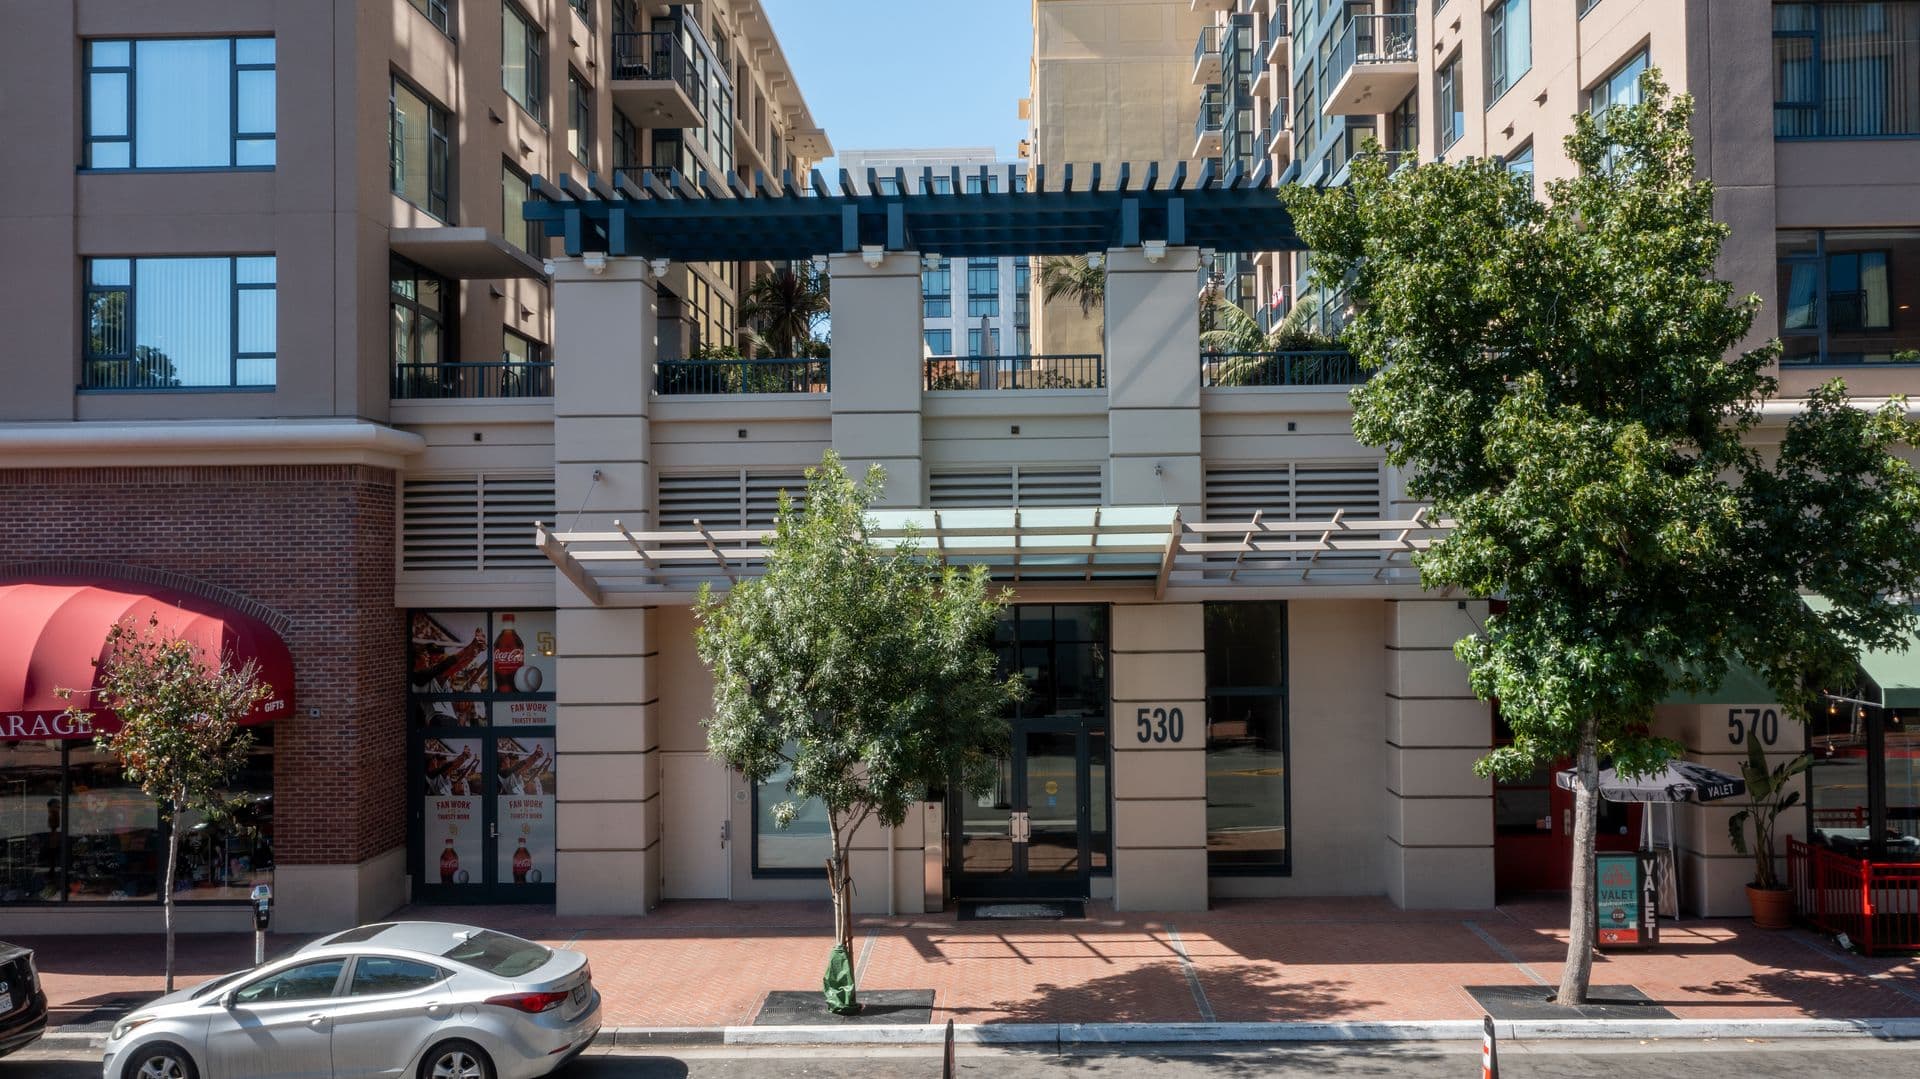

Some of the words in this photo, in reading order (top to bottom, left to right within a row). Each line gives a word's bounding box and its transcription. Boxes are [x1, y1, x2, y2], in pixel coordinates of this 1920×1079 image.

[264, 700, 285, 712] GIFTS
[510, 704, 525, 712] FAN
[526, 703, 548, 712] WORK
[0, 713, 93, 737] RAGE
[1137, 707, 1184, 743] 530
[1728, 708, 1778, 746] 570
[1707, 783, 1734, 797] VALET
[436, 801, 450, 810] FAN
[451, 800, 471, 810] WORK
[508, 800, 522, 809] FAN
[523, 799, 543, 808] WORK
[1601, 889, 1634, 900] VALET
[1642, 859, 1656, 939] VALET
